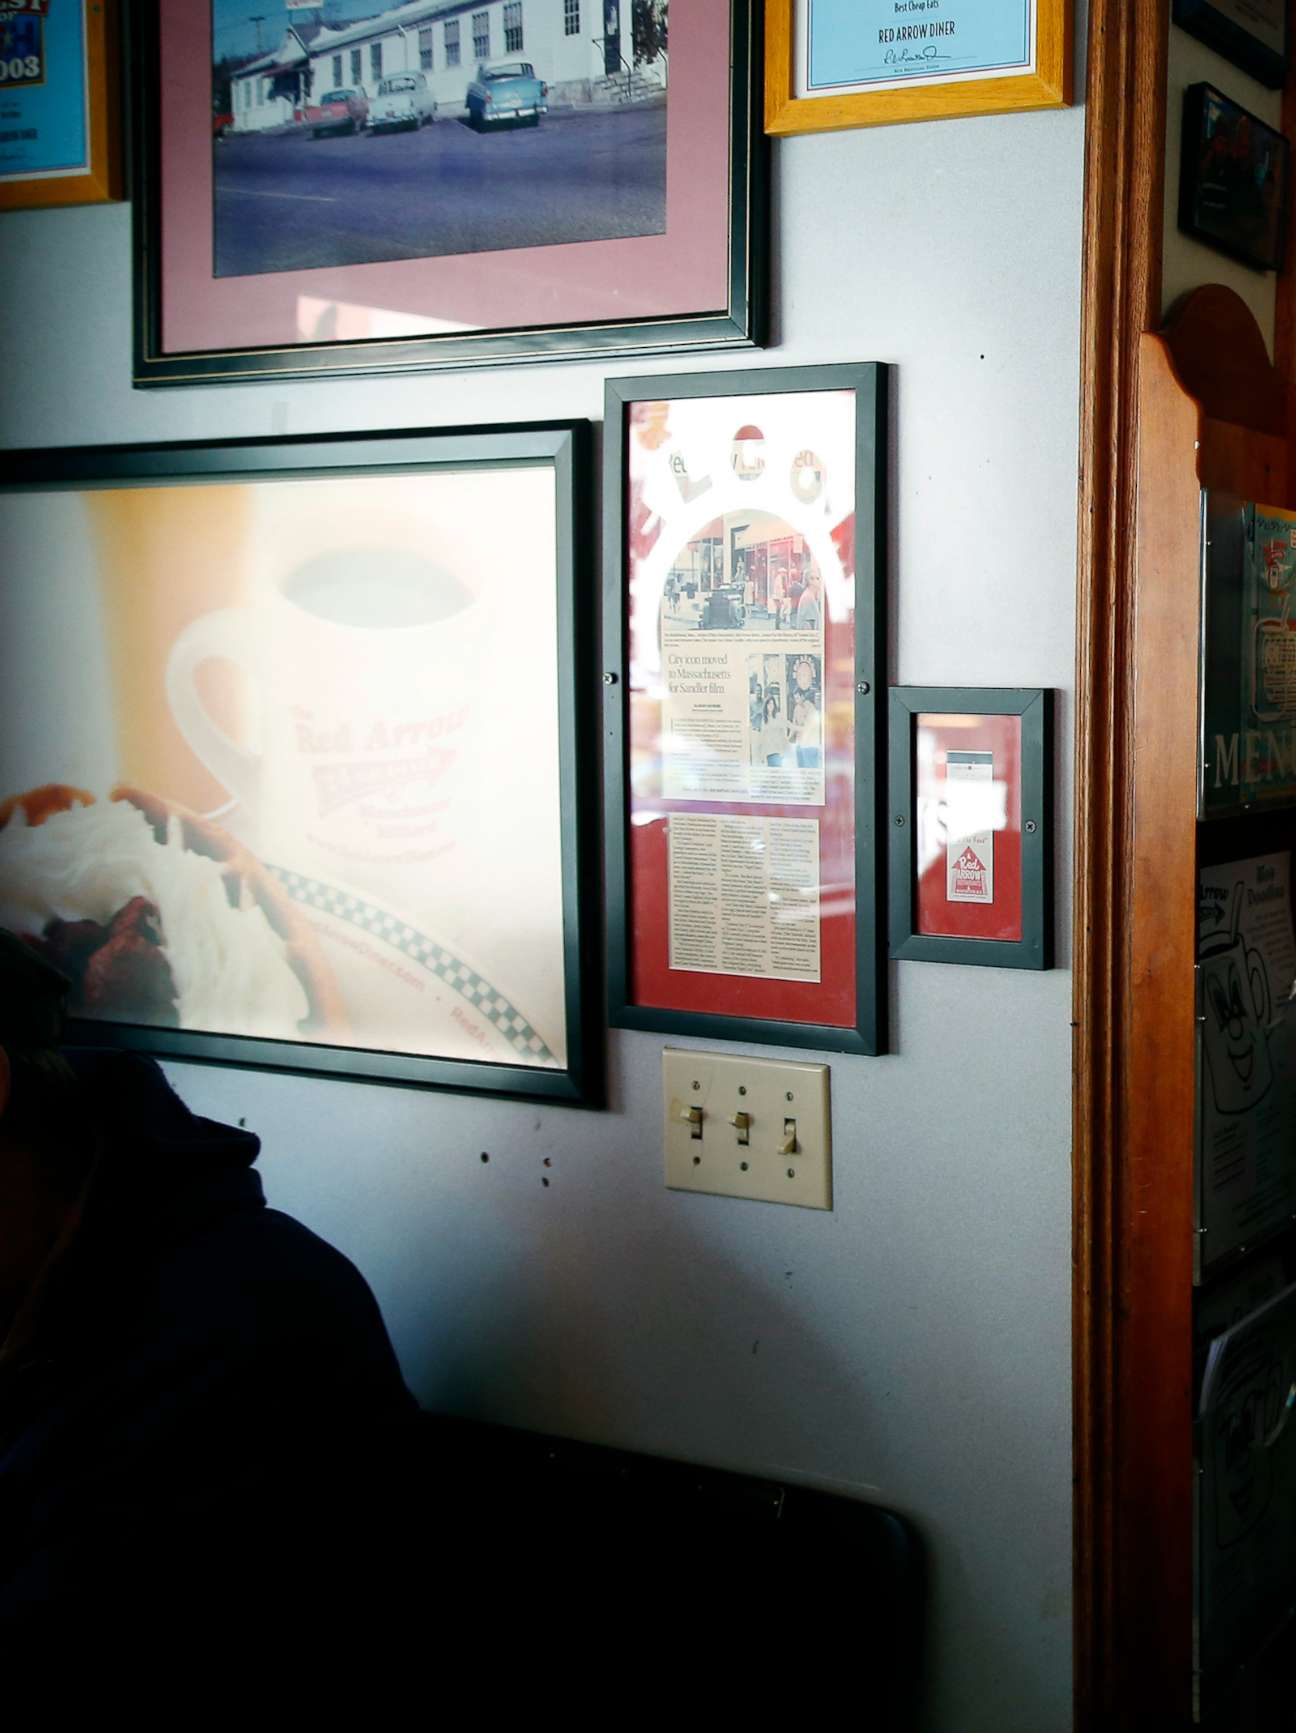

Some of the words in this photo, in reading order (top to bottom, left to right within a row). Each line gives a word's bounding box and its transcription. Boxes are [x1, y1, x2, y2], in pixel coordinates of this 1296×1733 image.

[894, 3, 907, 13] Best
[909, 1, 925, 12] Cheap
[878, 28, 894, 43] RED
[896, 24, 928, 41] ARROW
[929, 20, 955, 36] DINER
[702, 654, 727, 664] moved
[680, 682, 707, 693] Sandler
